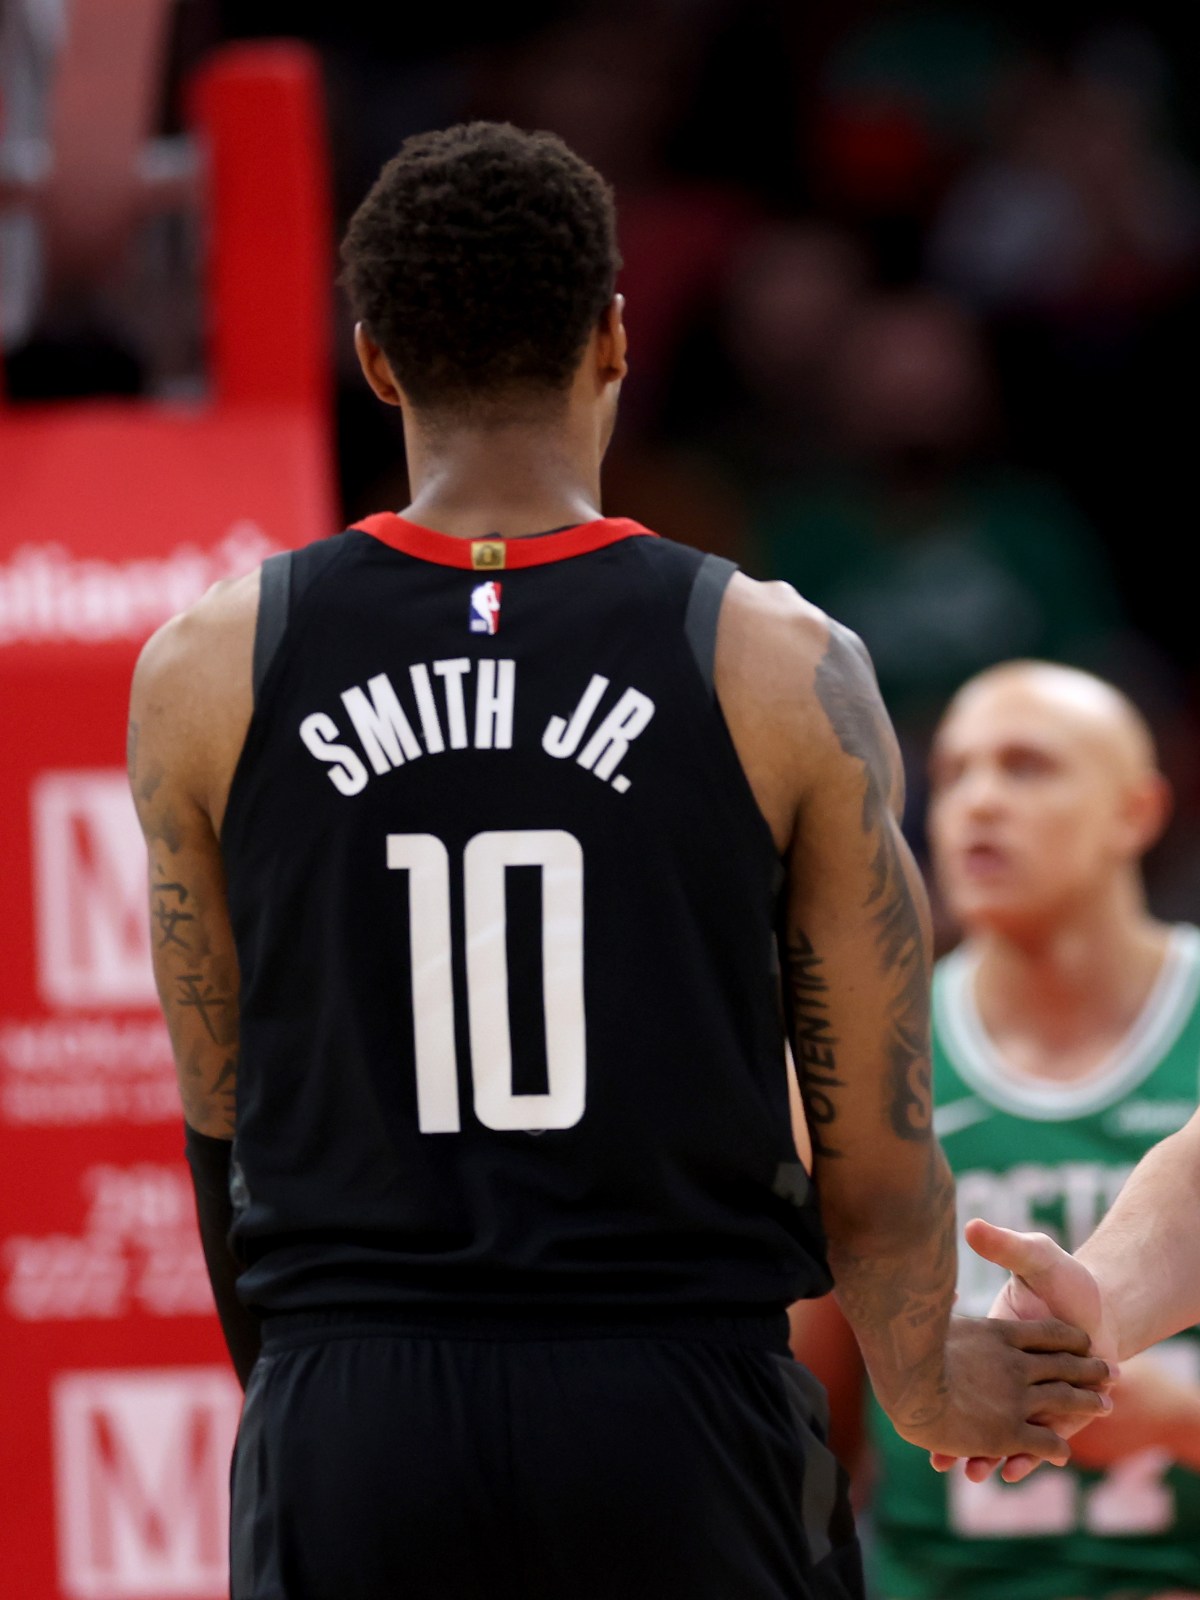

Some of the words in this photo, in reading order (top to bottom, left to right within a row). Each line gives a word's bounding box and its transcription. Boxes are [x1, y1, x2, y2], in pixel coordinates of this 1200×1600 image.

[300, 657, 516, 796] SMITH
[542, 674, 655, 793] JR.
[386, 829, 586, 1134] 10
